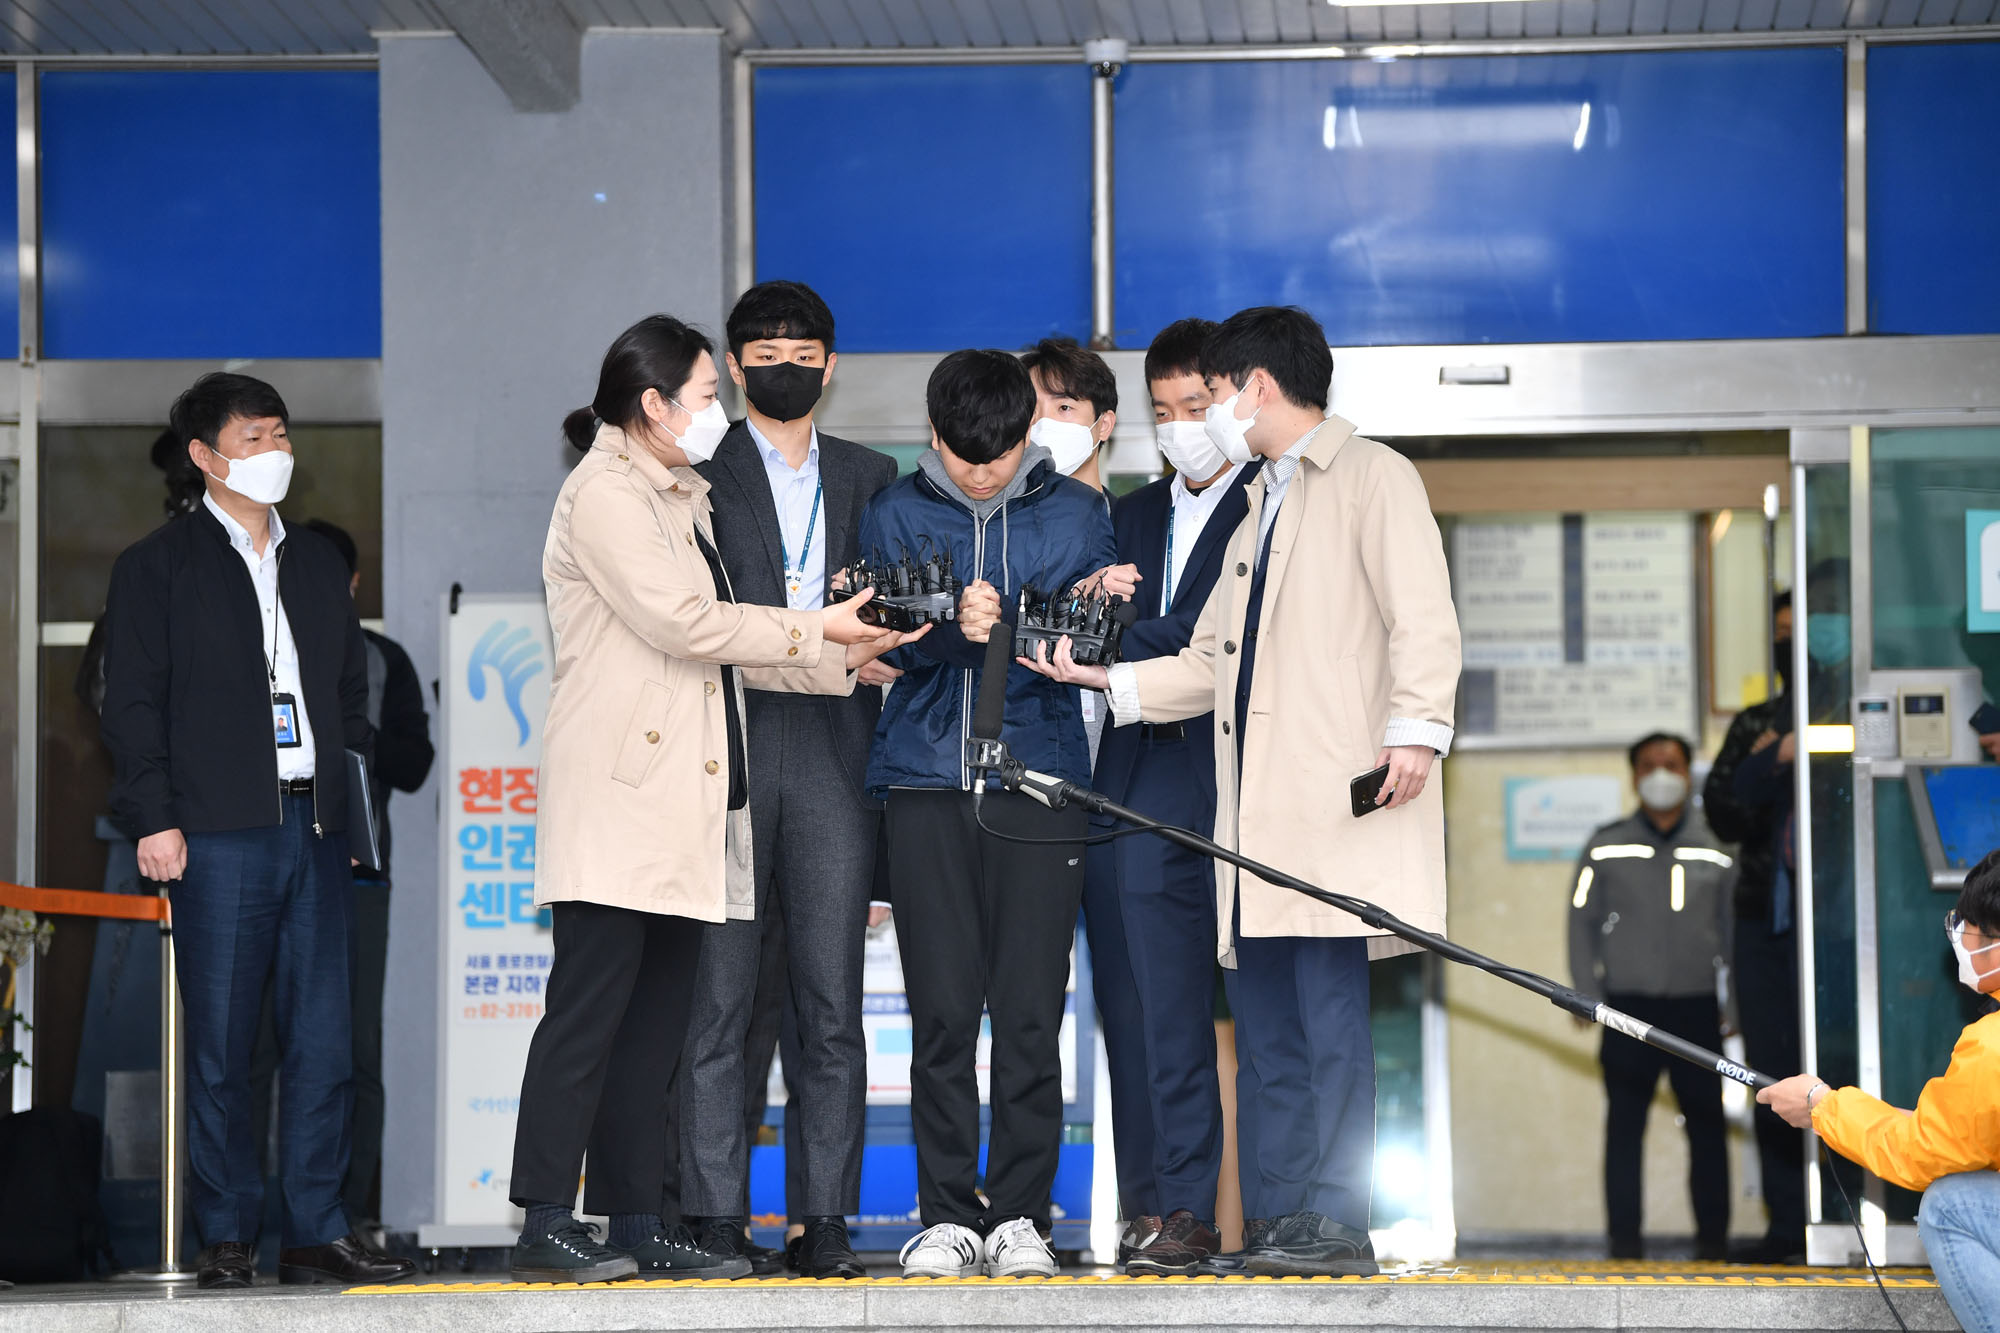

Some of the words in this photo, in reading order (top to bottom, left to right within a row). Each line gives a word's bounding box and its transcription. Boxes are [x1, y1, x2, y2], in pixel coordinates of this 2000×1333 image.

[459, 767, 539, 814] 현장
[466, 955, 490, 969] 서울
[497, 955, 555, 969] 종로경찰
[465, 976, 499, 995] 본관
[1716, 1058, 1757, 1086] RØDE
